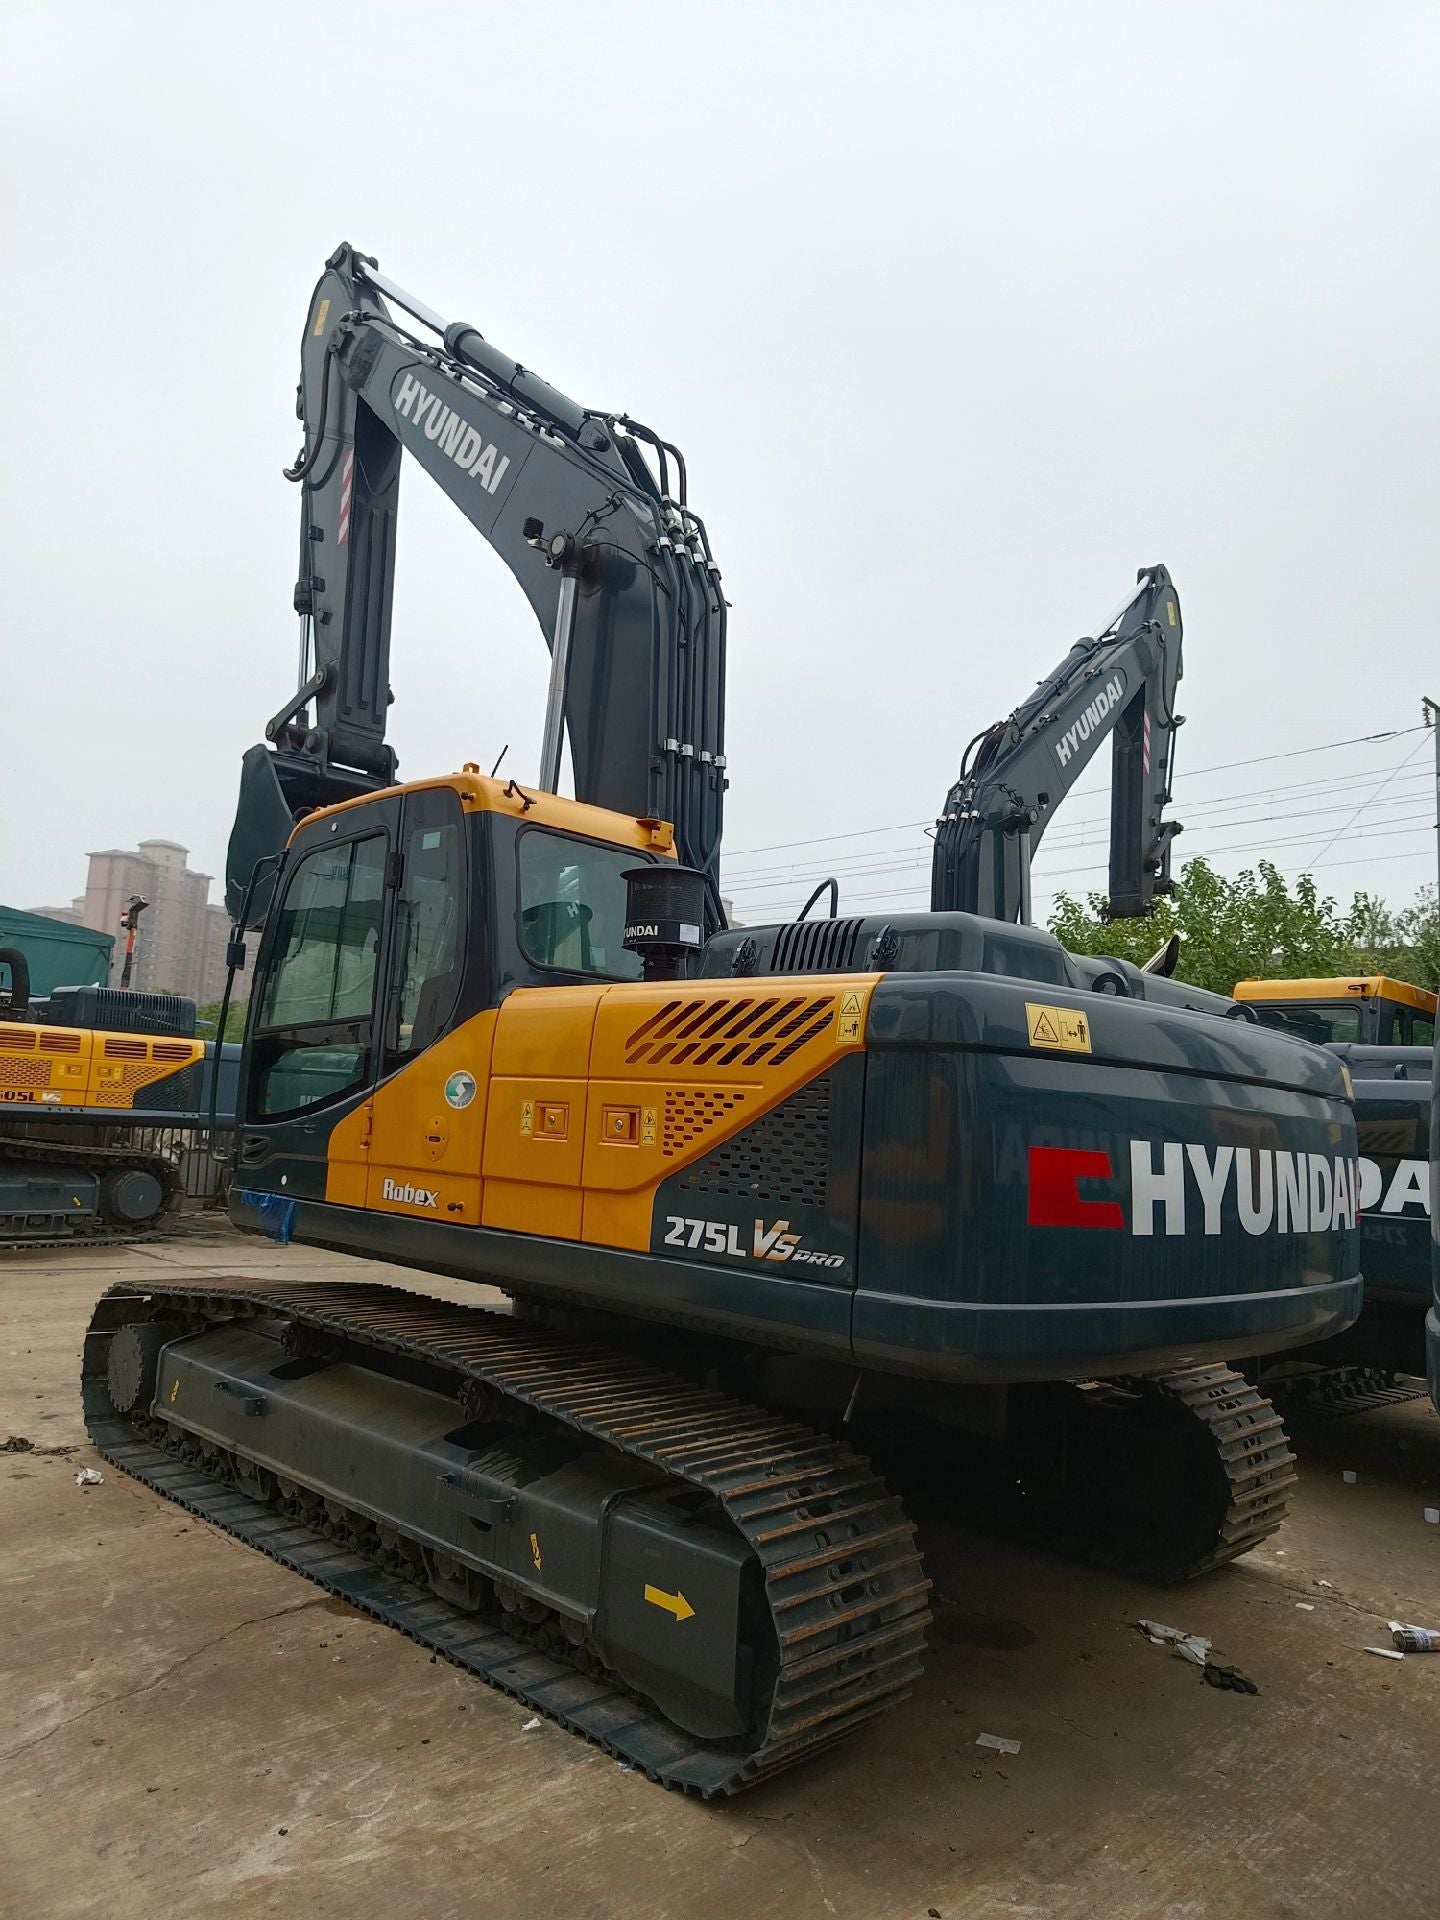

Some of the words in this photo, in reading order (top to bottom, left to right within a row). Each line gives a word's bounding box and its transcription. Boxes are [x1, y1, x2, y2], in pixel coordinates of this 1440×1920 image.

[394, 372, 511, 496] HYUNDAI
[1055, 674, 1123, 767] HYUNDAI
[0, 1091, 37, 1102] 05L
[1130, 1140, 1356, 1236] HYUNDAI
[664, 1216, 746, 1257] 275L
[793, 1250, 845, 1268] PRO
